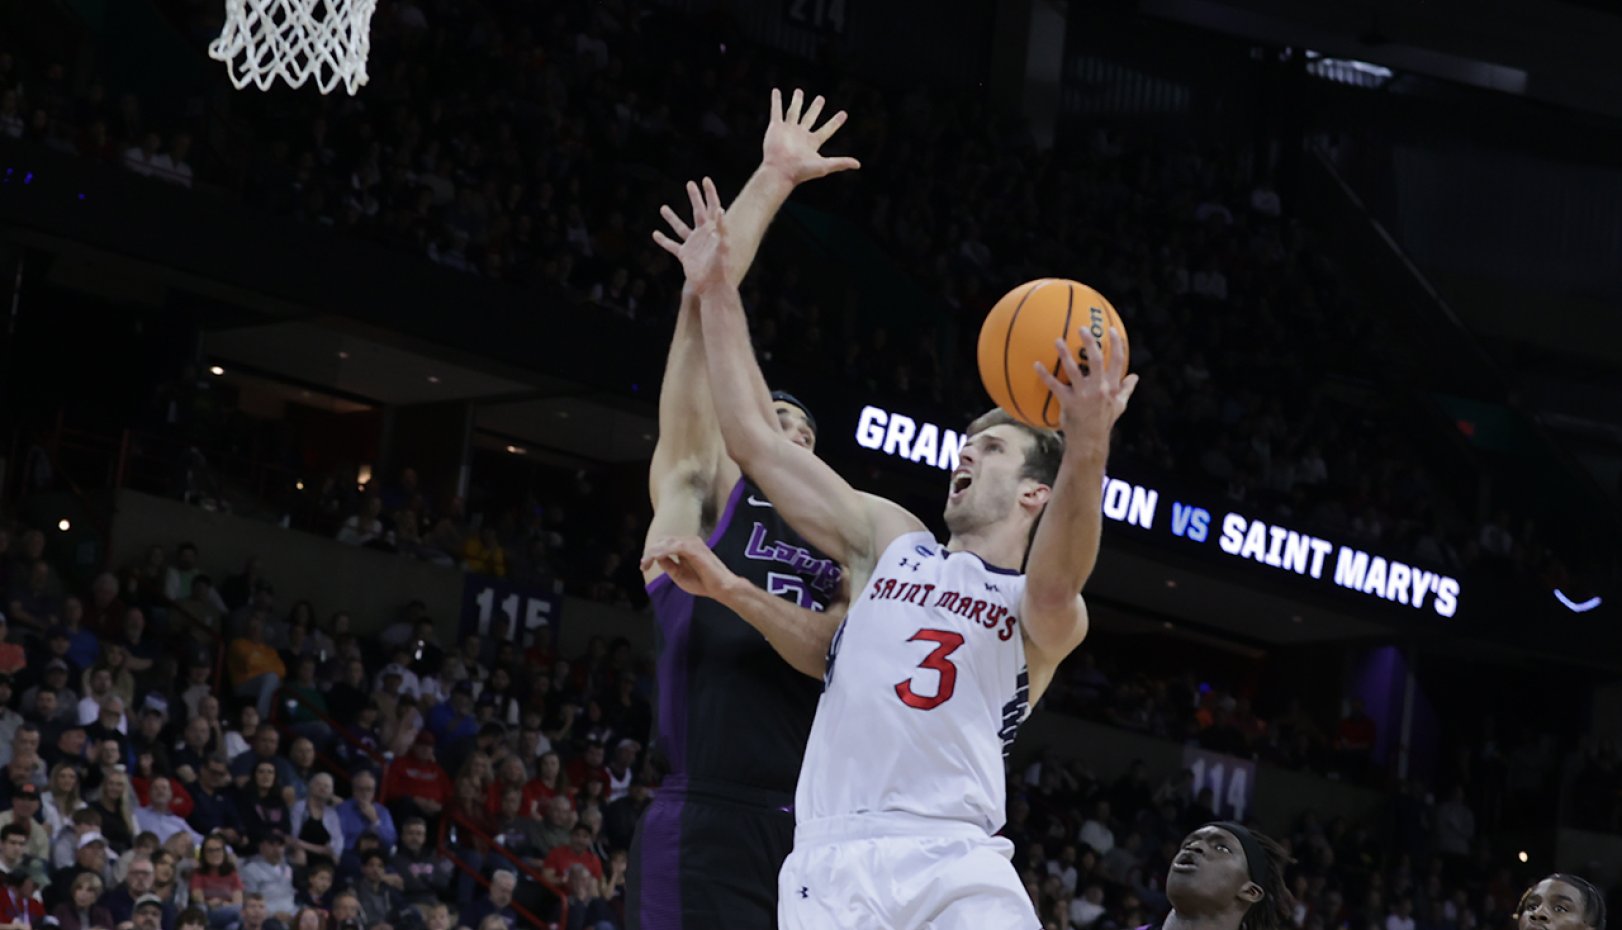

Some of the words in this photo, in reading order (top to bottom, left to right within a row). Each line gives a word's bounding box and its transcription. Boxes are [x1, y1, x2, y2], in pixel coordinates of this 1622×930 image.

[855, 404, 968, 472] GRAN
[1170, 501, 1212, 544] VS
[1218, 511, 1334, 580] SAINT
[1333, 545, 1462, 618] MARY'S
[476, 586, 551, 643] 115
[870, 578, 936, 607] SAINT
[935, 591, 1016, 641] MARY'S
[894, 628, 965, 711] 3
[1191, 758, 1247, 822] 114
